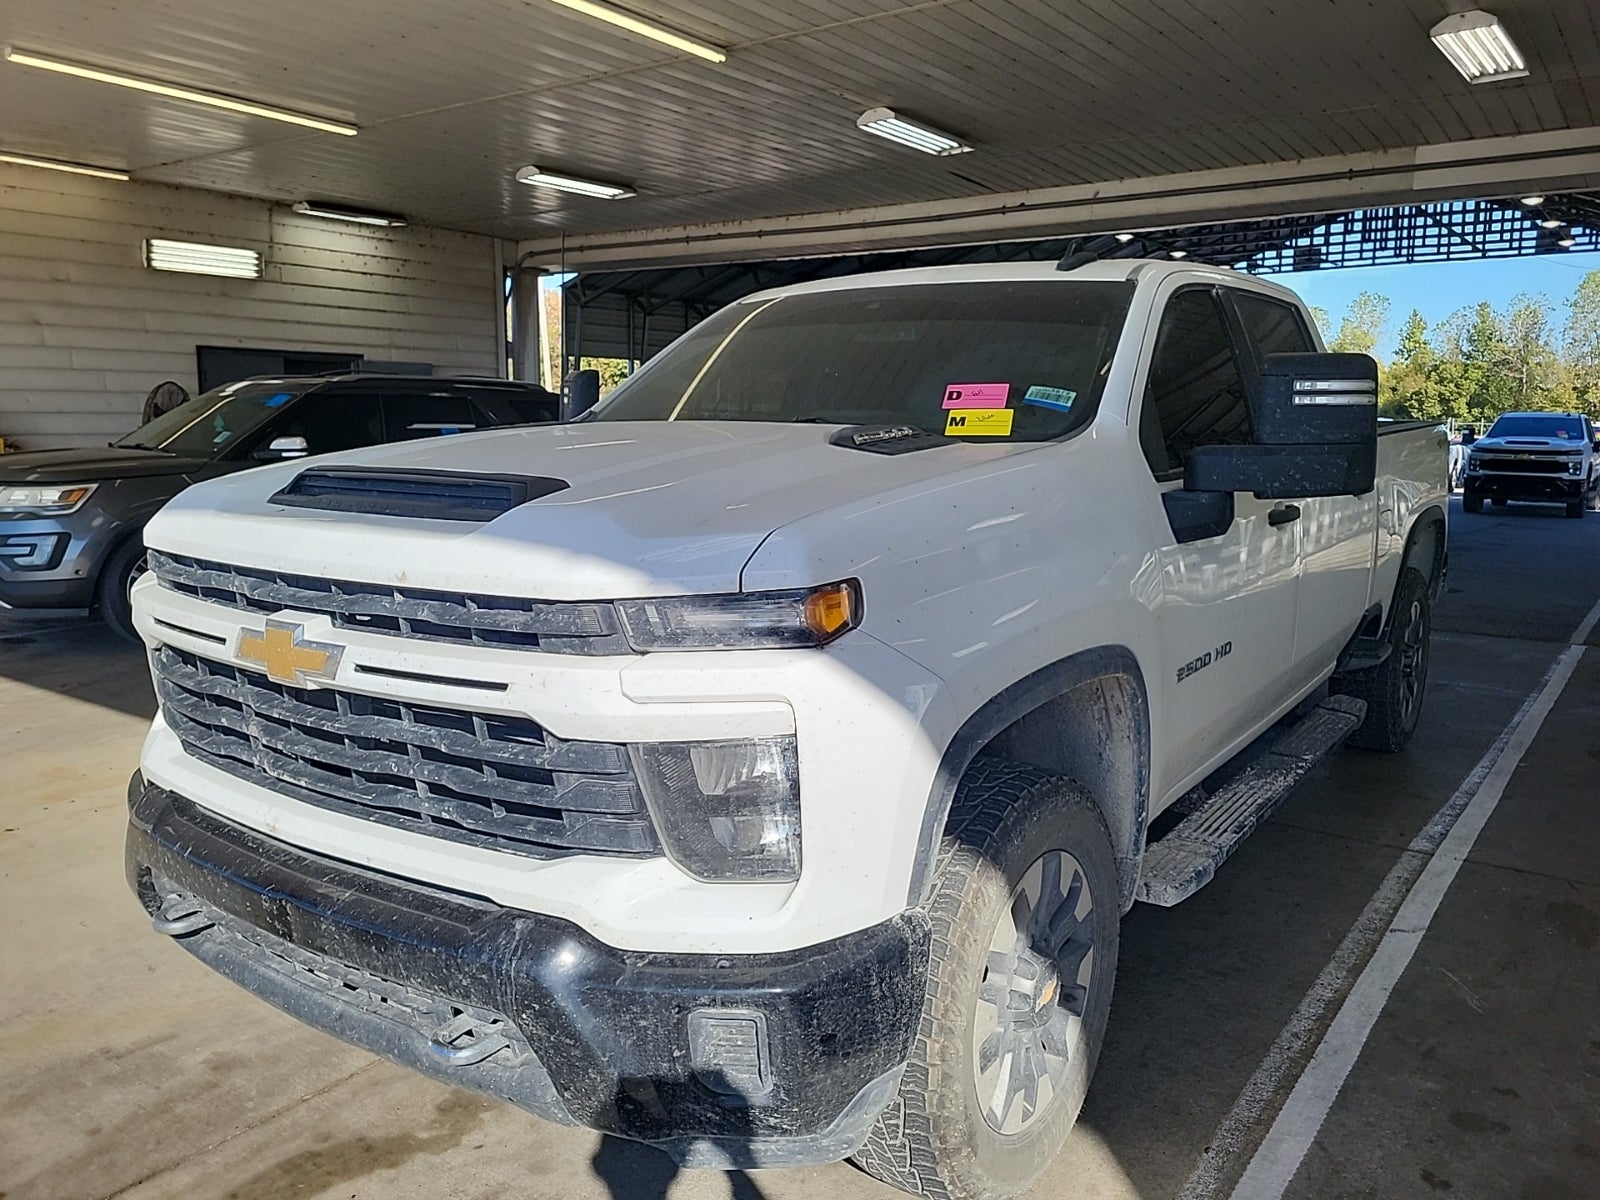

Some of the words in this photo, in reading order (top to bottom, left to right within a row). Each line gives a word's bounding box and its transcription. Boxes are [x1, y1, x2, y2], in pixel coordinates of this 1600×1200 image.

[946, 390, 963, 401] D
[949, 416, 967, 427] M
[1176, 652, 1212, 684] 2500
[1214, 641, 1232, 662] HD
